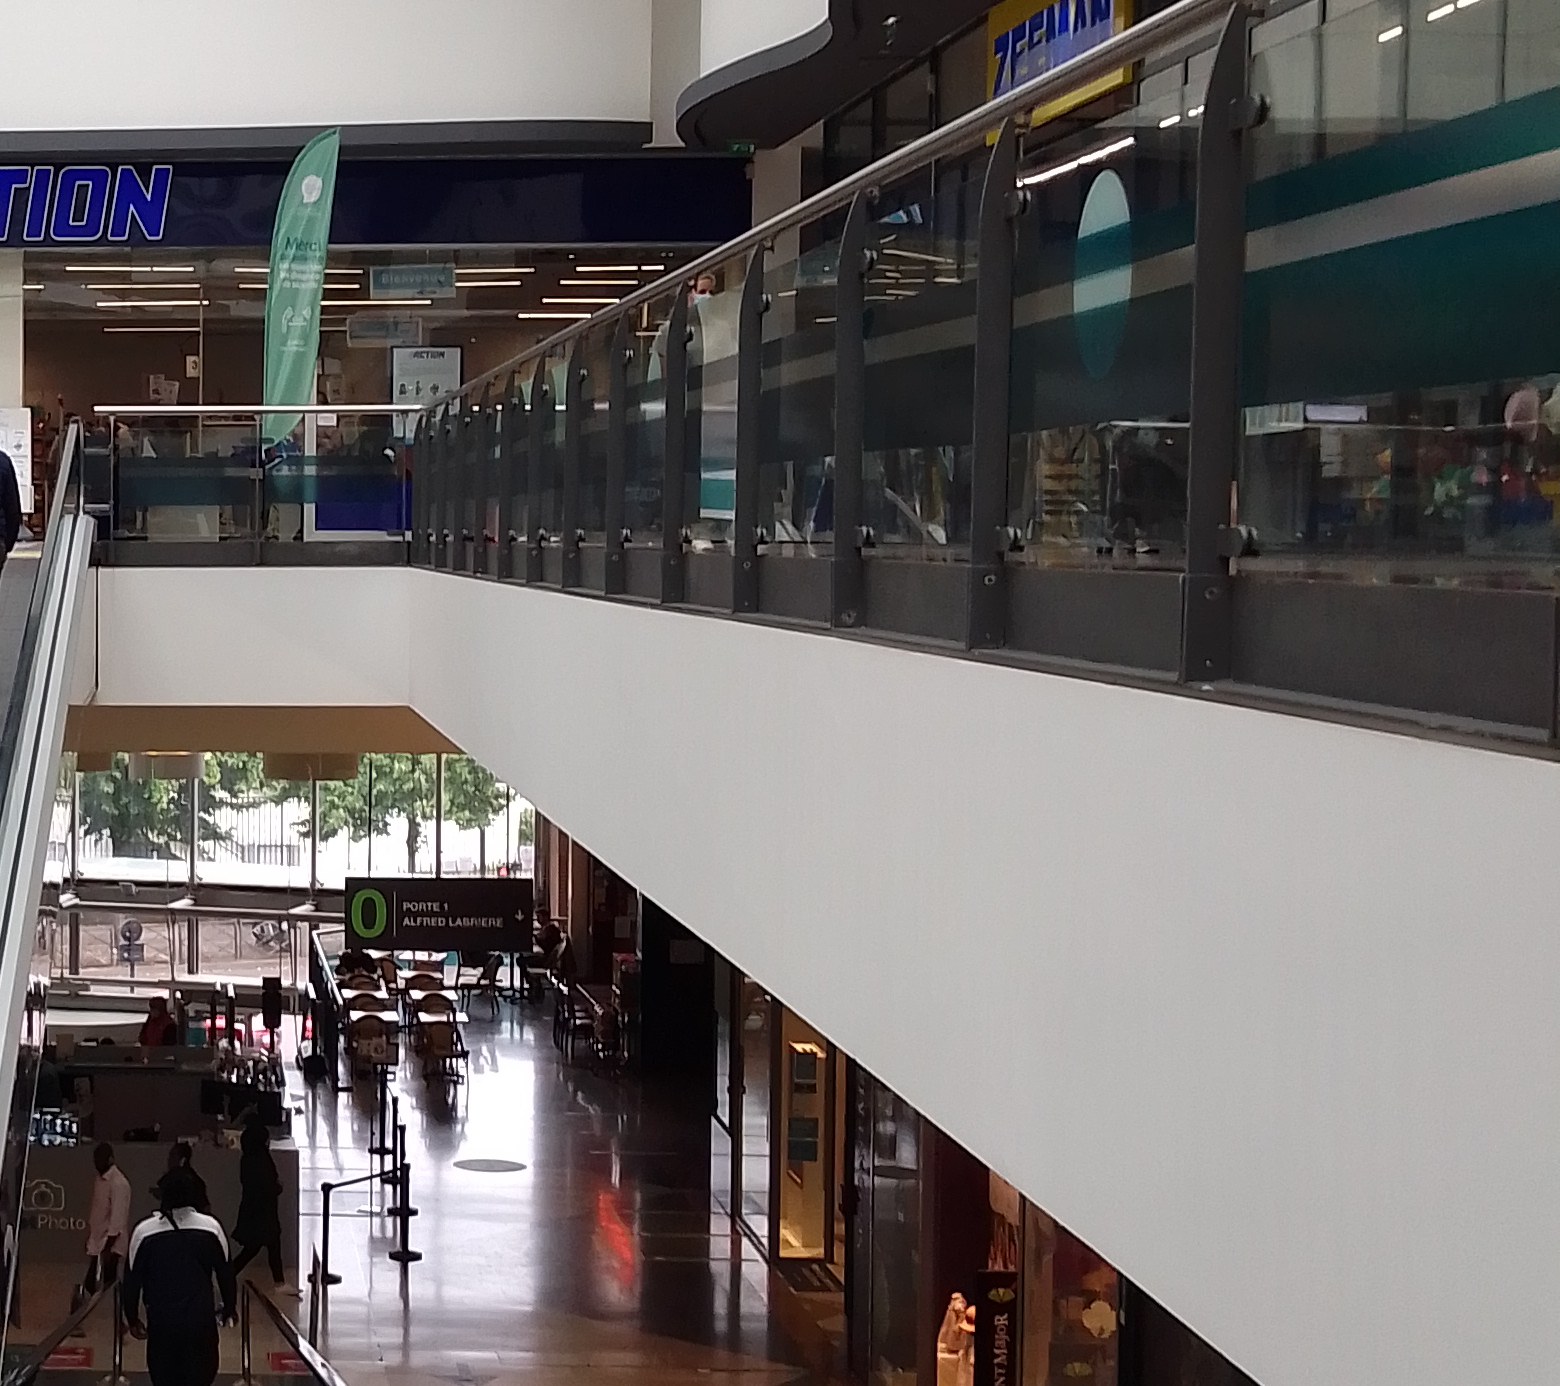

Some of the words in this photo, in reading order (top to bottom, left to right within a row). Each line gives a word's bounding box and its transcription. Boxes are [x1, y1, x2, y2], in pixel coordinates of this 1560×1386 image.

[284, 235, 322, 253] Merci
[412, 350, 446, 359] ACTION
[402, 901, 440, 912] PORTE
[443, 902, 449, 912] 1
[351, 888, 387, 939] 0
[402, 916, 446, 927] ALFRED
[37, 1214, 87, 1230] Photo
